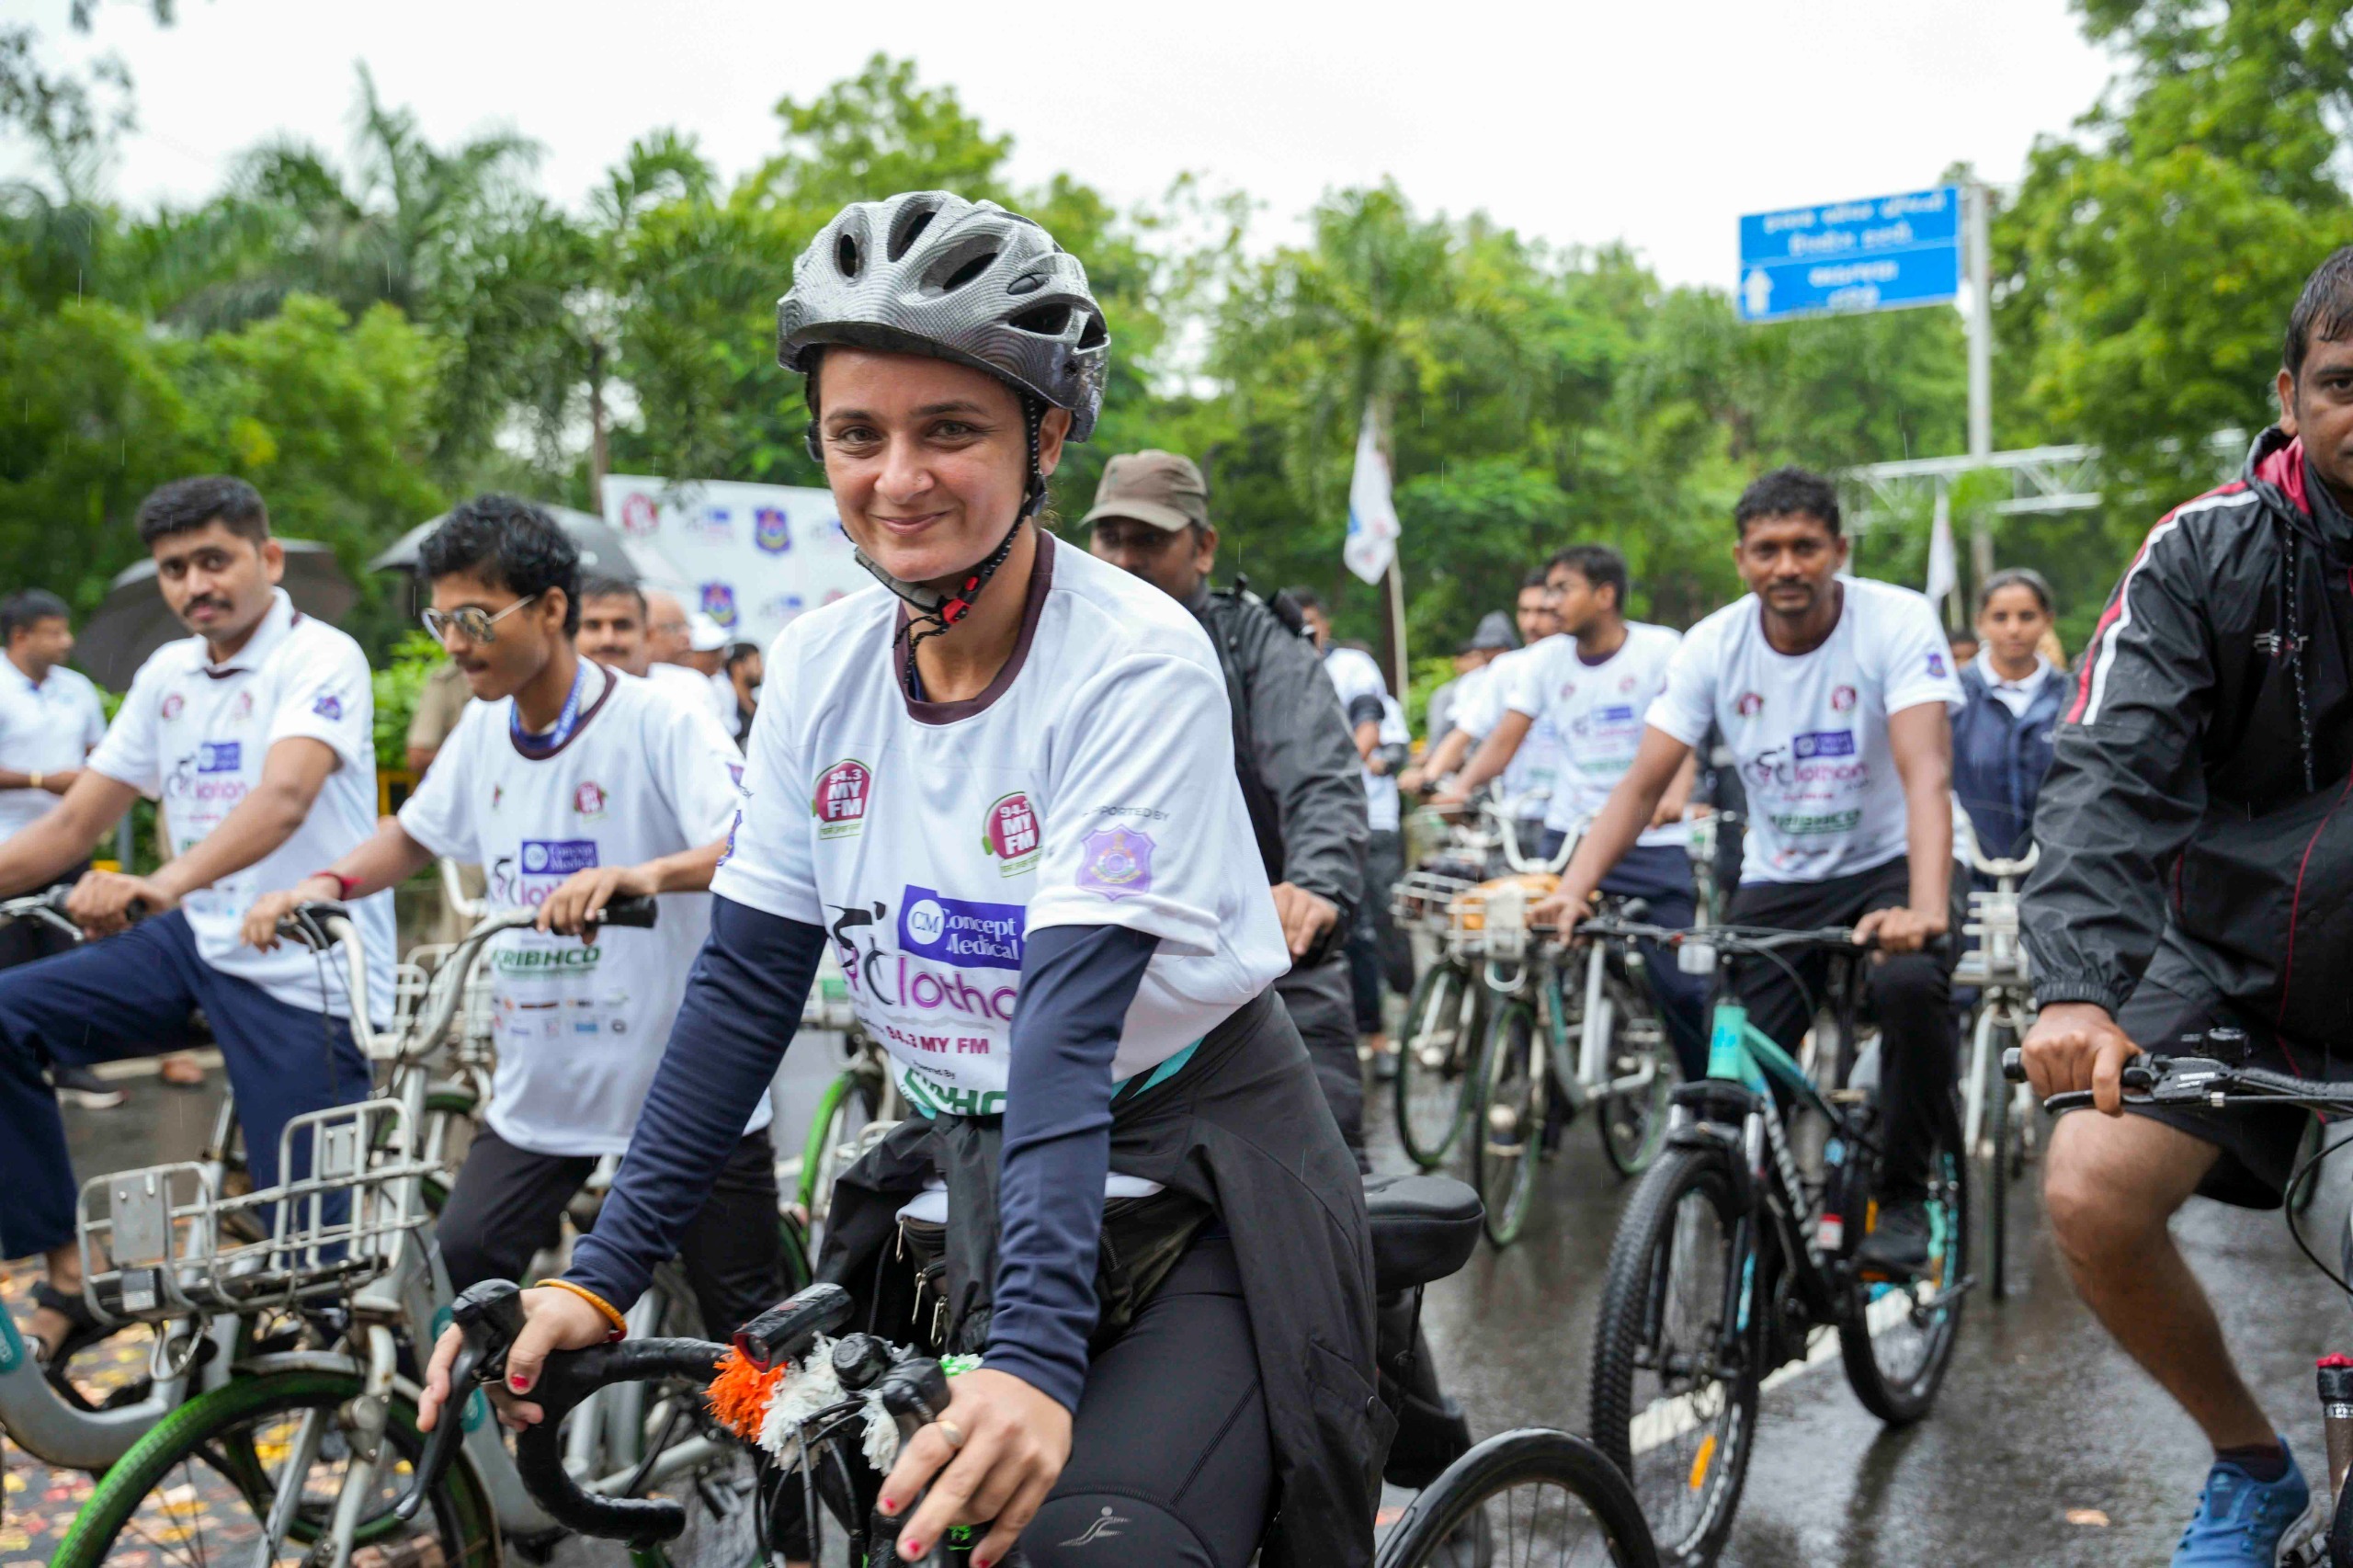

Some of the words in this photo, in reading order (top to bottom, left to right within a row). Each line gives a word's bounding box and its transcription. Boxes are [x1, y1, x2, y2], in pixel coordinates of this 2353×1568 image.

[829, 768, 862, 784] 94.3
[827, 780, 862, 801] MY
[827, 798, 862, 818] FM
[1001, 812, 1031, 836] MY
[1004, 829, 1036, 855] FM
[912, 910, 942, 934] CM
[920, 1035, 950, 1053] MY
[957, 1038, 990, 1054] FM
